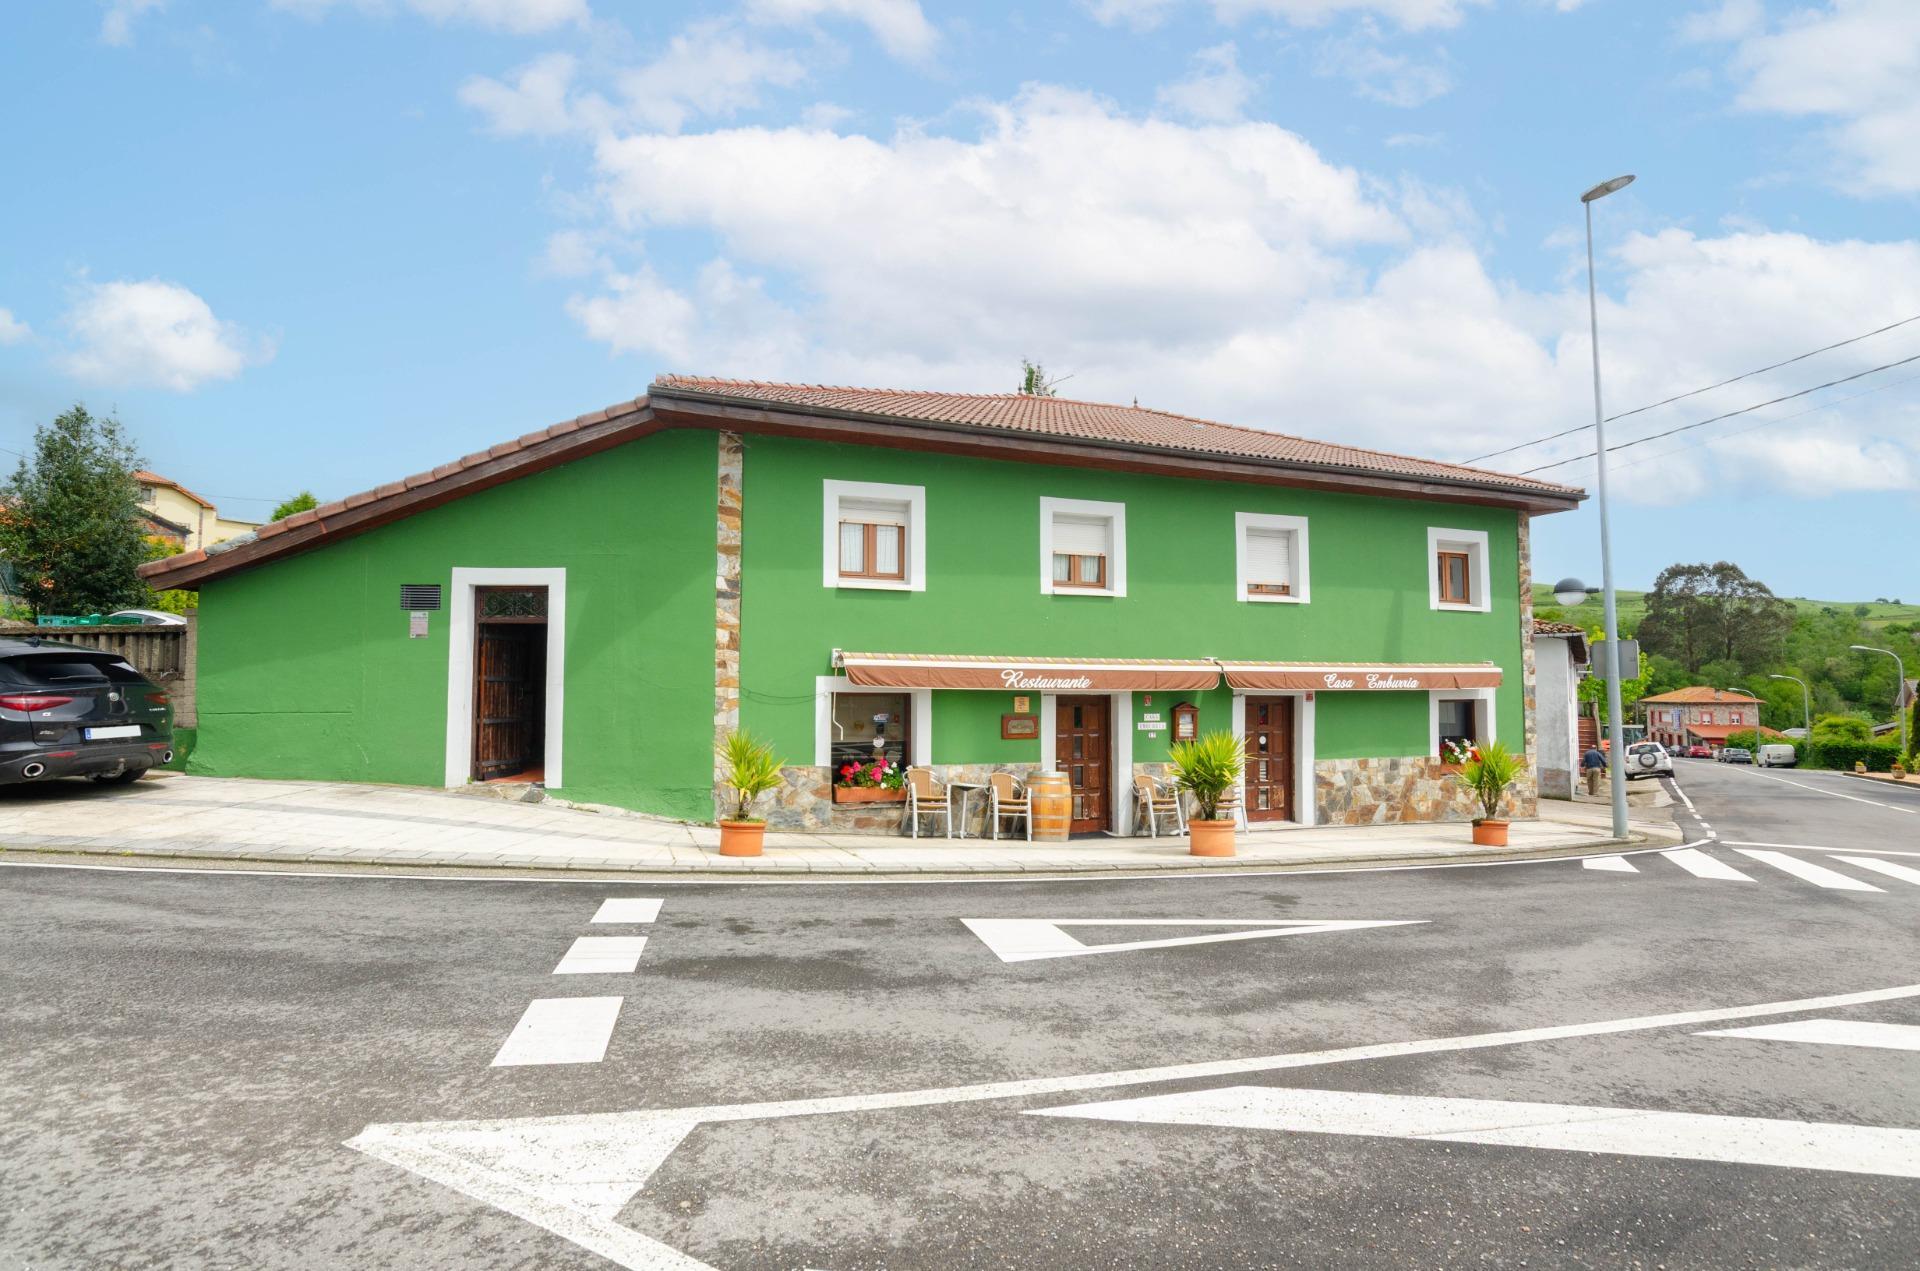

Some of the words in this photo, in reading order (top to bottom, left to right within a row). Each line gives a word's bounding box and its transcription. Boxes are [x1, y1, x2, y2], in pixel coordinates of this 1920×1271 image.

[1000, 669, 1093, 689] Restaurante
[1323, 673, 1355, 689] Casa
[1366, 673, 1419, 689] Emburria
